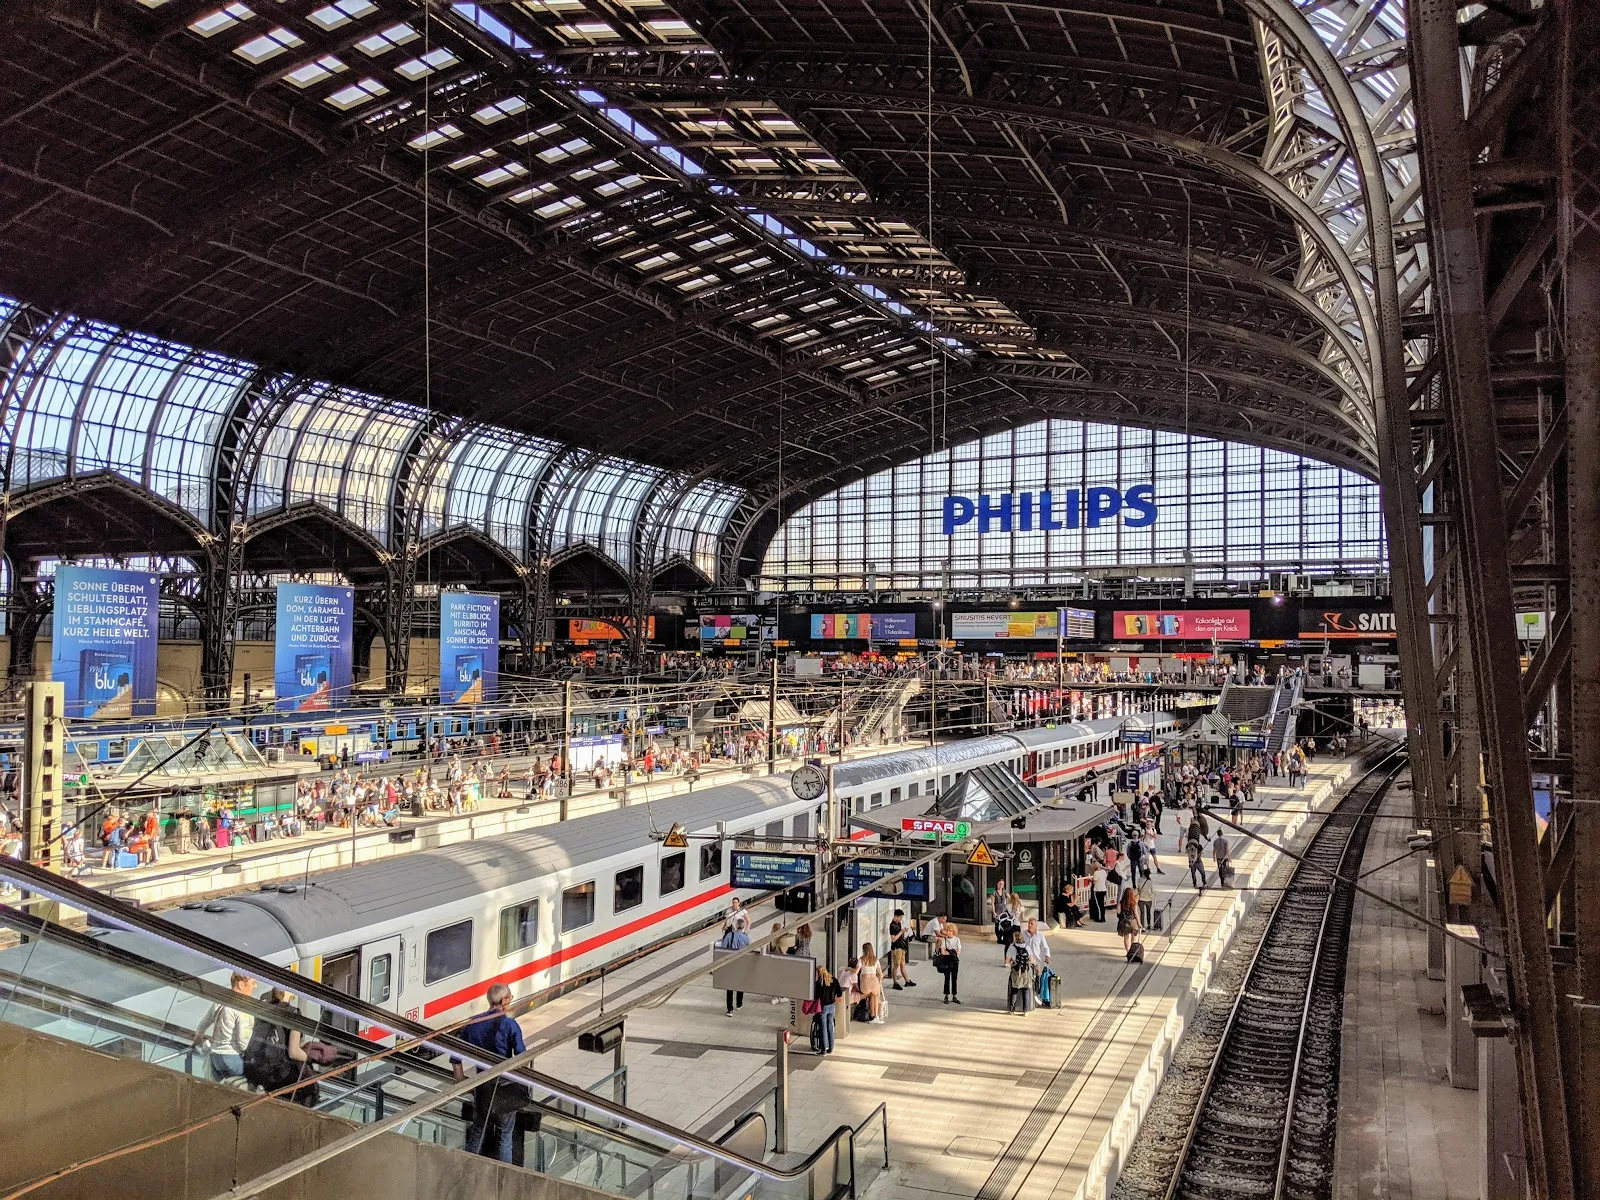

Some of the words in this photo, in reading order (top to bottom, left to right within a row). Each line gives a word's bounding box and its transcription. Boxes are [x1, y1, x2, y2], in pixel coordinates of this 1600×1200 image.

[943, 484, 1158, 535] PHILIPS
[73, 581, 108, 592] SONNE
[111, 581, 144, 594] ÜBERM
[67, 592, 149, 606] SCHULTERBLATT,
[294, 595, 313, 604] KURZ
[315, 595, 339, 605] ÜBERN
[67, 604, 148, 616] LIEBLINGSPLATZ
[286, 605, 306, 614] DOM,
[308, 606, 345, 615] KARAMELL
[450, 603, 465, 611] PARK
[467, 604, 491, 612] FICTION
[294, 615, 302, 623] IN
[304, 615, 318, 623] DER
[320, 616, 339, 625] LUFT,
[462, 612, 491, 621] ELBBLICK,
[68, 616, 80, 625] IM
[84, 616, 146, 628] STAMMCAFÉ,
[454, 620, 479, 628] BURRITO
[63, 628, 89, 637] KURZ
[93, 628, 120, 637] HEILE
[123, 628, 150, 638] WELT.
[291, 625, 339, 633] ACHTERBAHN
[454, 629, 488, 637] ANSCHLAG,
[1223, 624, 1239, 632] Knick.
[291, 634, 307, 642] UND
[310, 634, 339, 643] ZURÜCK.
[477, 637, 495, 645] SICHT.
[95, 672, 115, 690] blu
[301, 672, 315, 687] blu
[63, 773, 80, 781] PAR
[1127, 771, 1137, 787] E
[556, 780, 568, 788] 286
[559, 788, 564, 796] 6
[913, 821, 954, 832] SPAR
[736, 855, 745, 865] 11
[913, 866, 924, 877] 12
[412, 943, 417, 959] 1
[407, 1010, 418, 1021] DB
